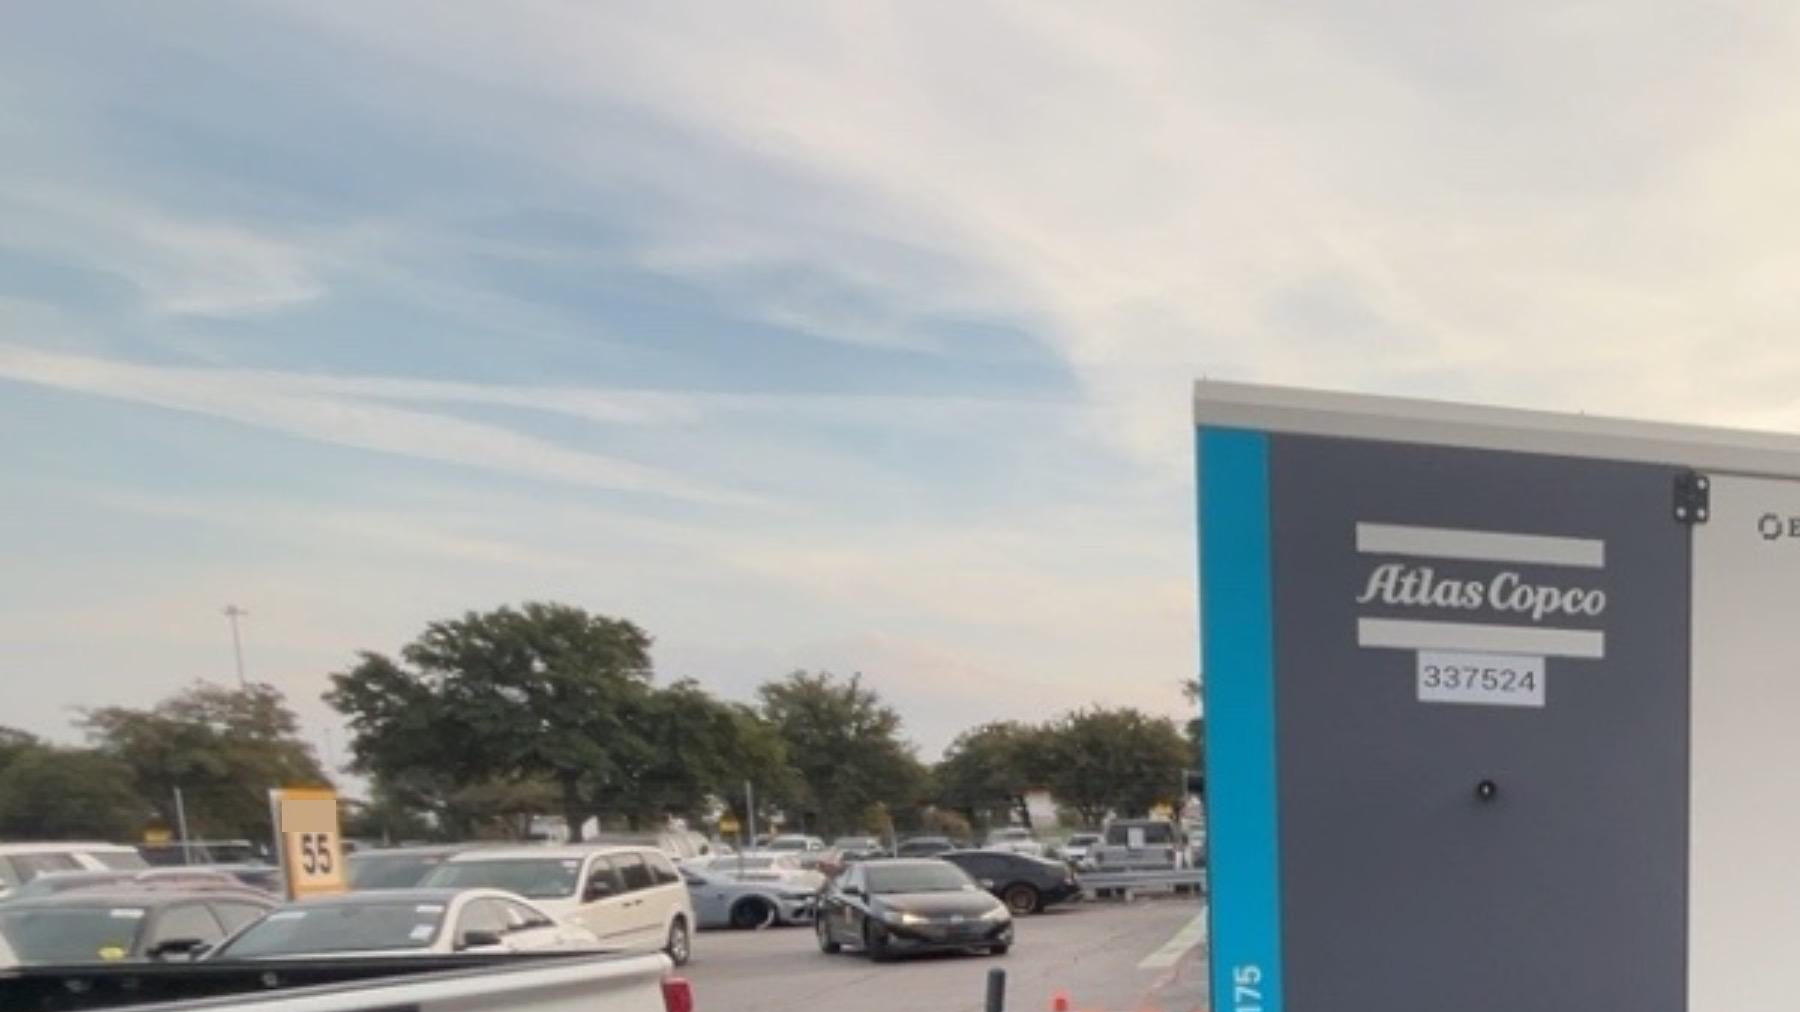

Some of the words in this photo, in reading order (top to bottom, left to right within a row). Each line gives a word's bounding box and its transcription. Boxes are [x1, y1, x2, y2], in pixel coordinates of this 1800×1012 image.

[1356, 562, 1484, 609] Atlas
[1488, 570, 1606, 621] Copco
[1423, 664, 1535, 693] 337524
[301, 832, 334, 875] 55
